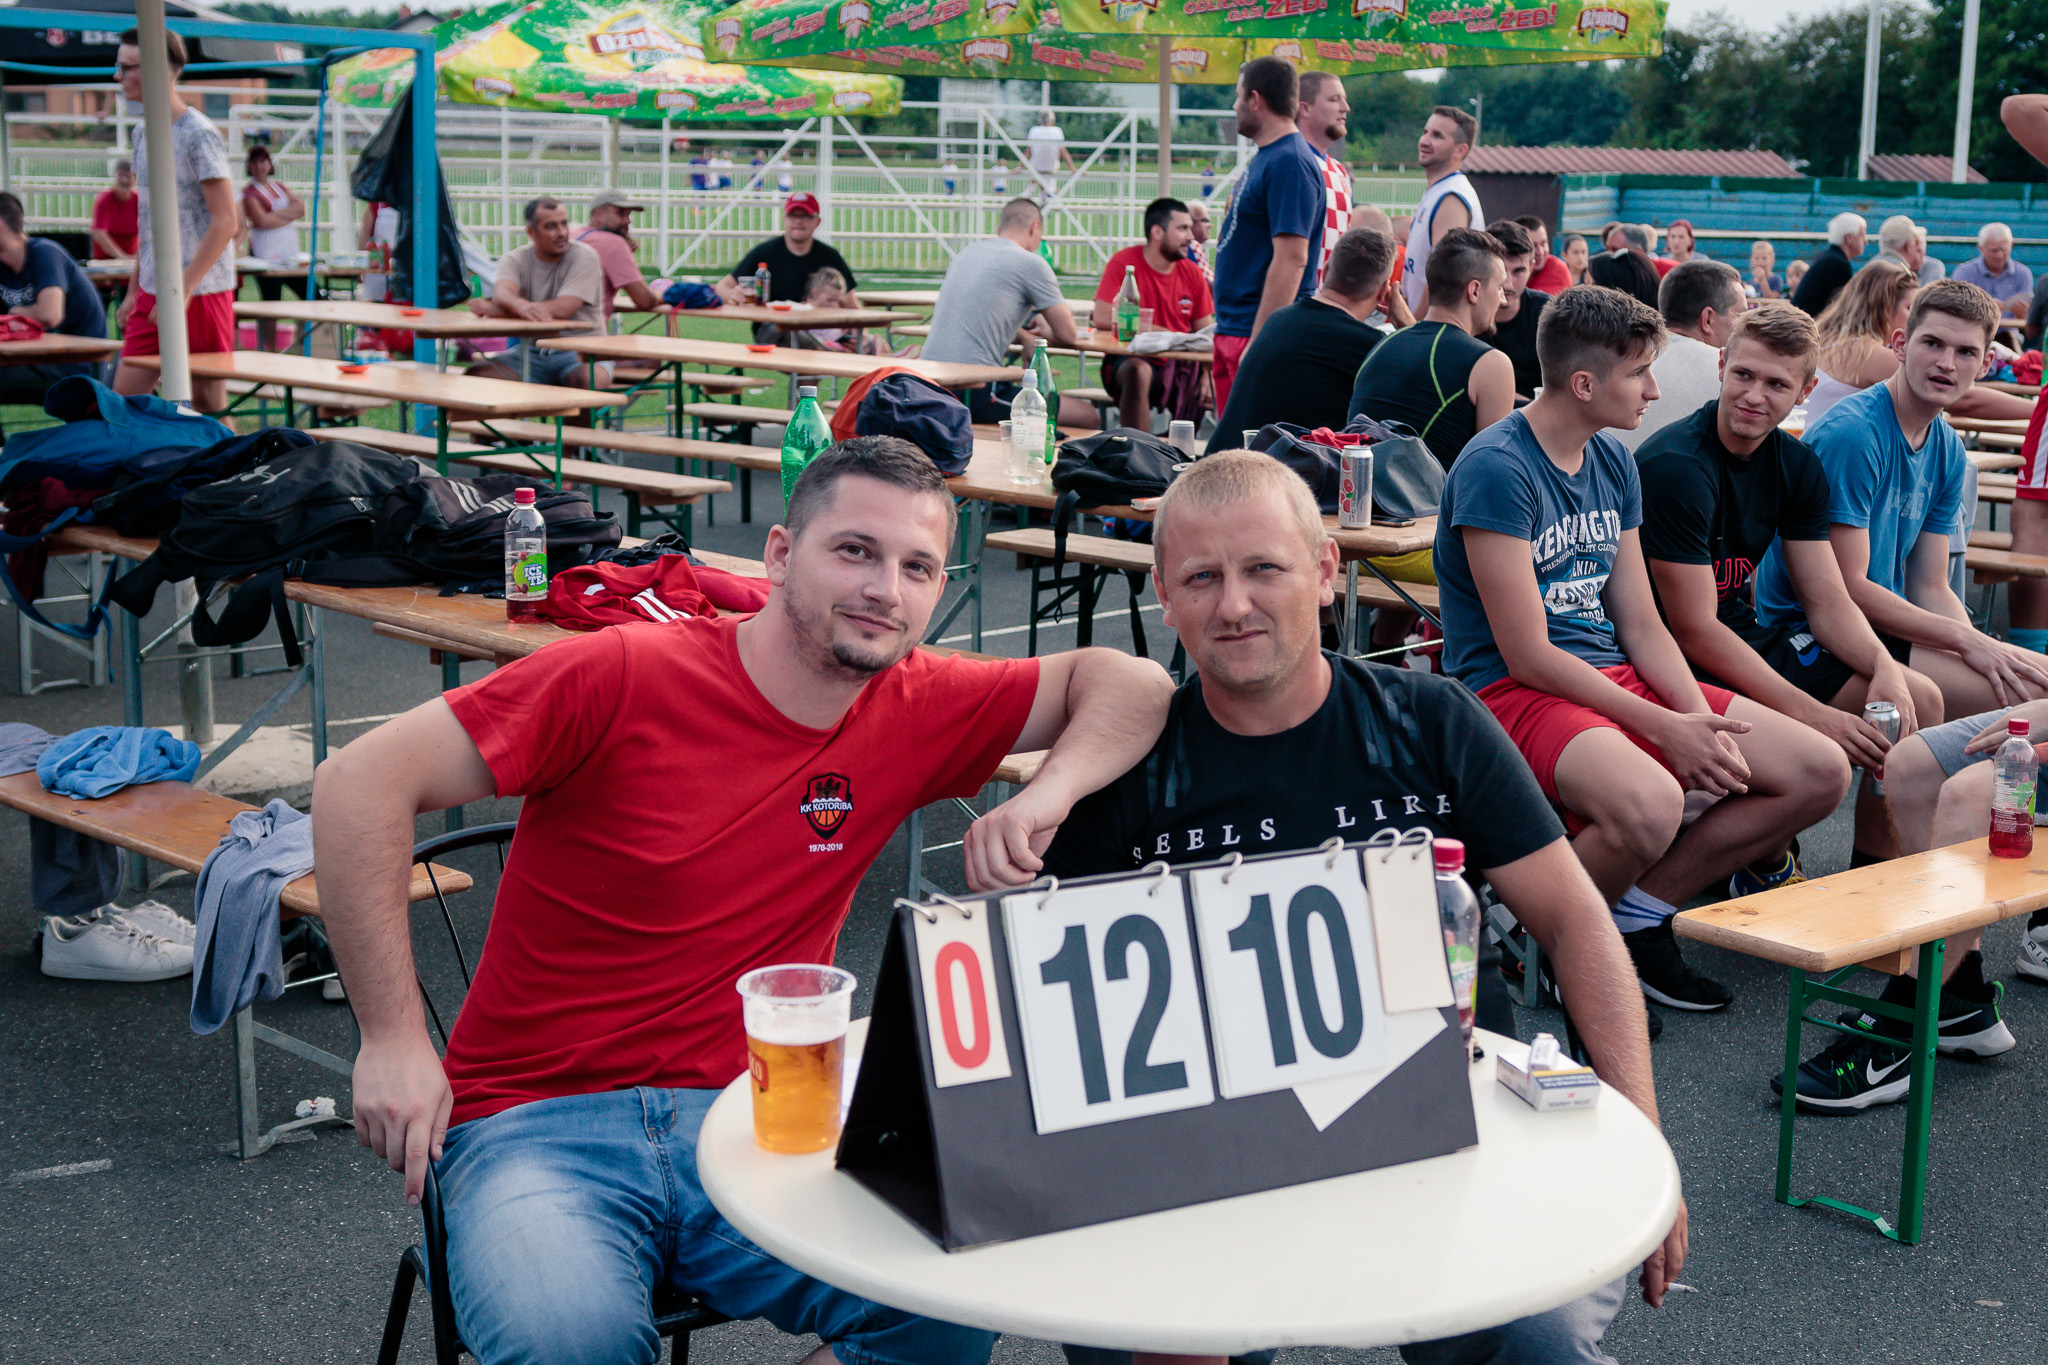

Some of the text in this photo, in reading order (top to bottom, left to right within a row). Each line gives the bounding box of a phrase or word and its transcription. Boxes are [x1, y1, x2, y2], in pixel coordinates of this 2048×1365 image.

[1227, 5, 1264, 22] GASI
[1428, 4, 1493, 25] ODLIČNO
[1465, 19, 1499, 34] GASI
[1541, 548, 1576, 573] PREMIUM
[525, 566, 542, 577] ICE
[528, 573, 547, 586] TEA
[800, 802, 853, 813] KK KOTORIBA
[934, 884, 1364, 1106] 0 12 10
[1859, 1012, 1877, 1027] NIKE
